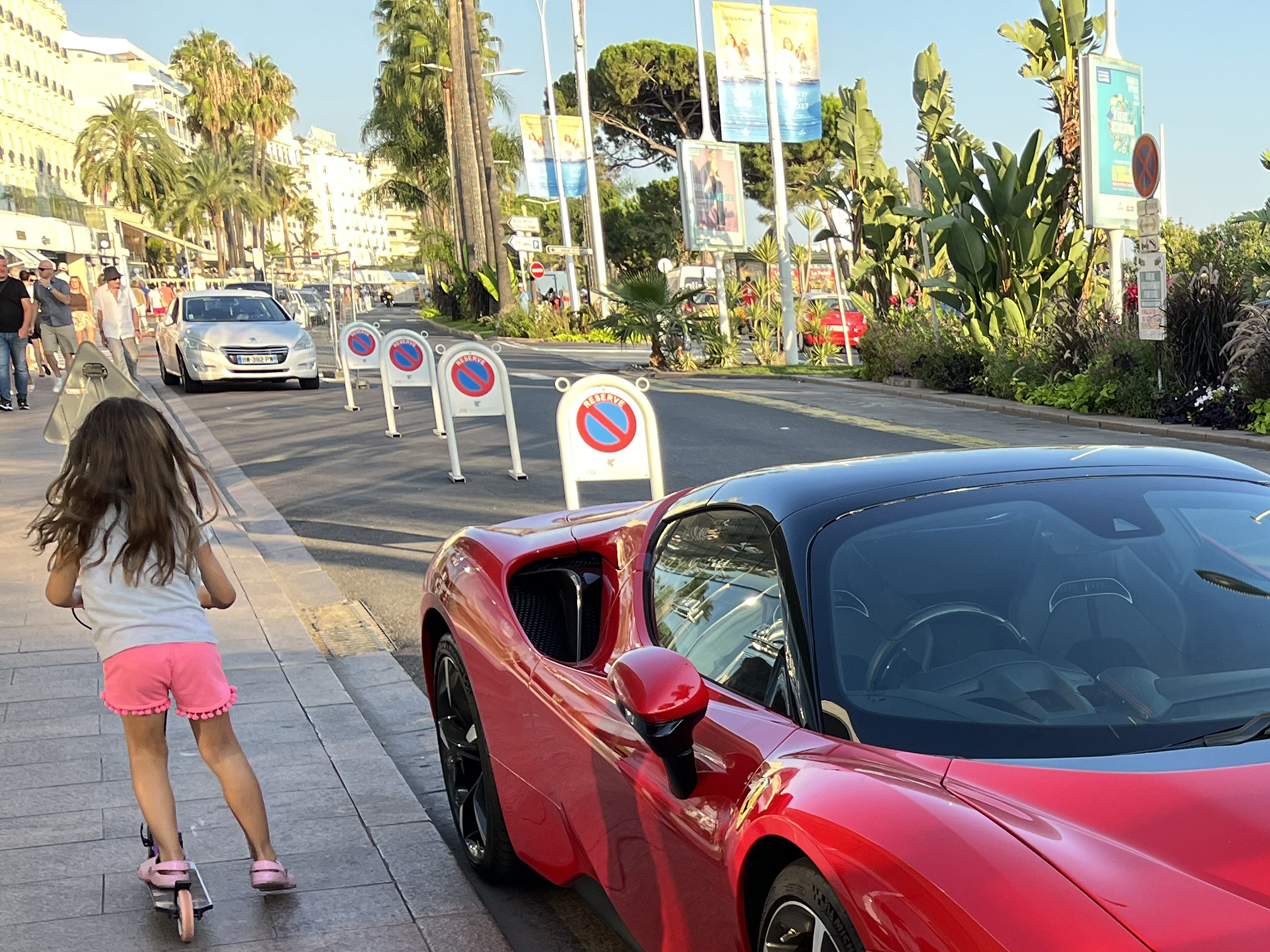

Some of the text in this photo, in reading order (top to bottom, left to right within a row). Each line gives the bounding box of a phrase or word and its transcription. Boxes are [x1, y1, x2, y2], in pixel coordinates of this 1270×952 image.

[393, 339, 416, 348] RESERVE
[456, 355, 486, 367] RESERVE
[583, 394, 625, 409] RESERVE
